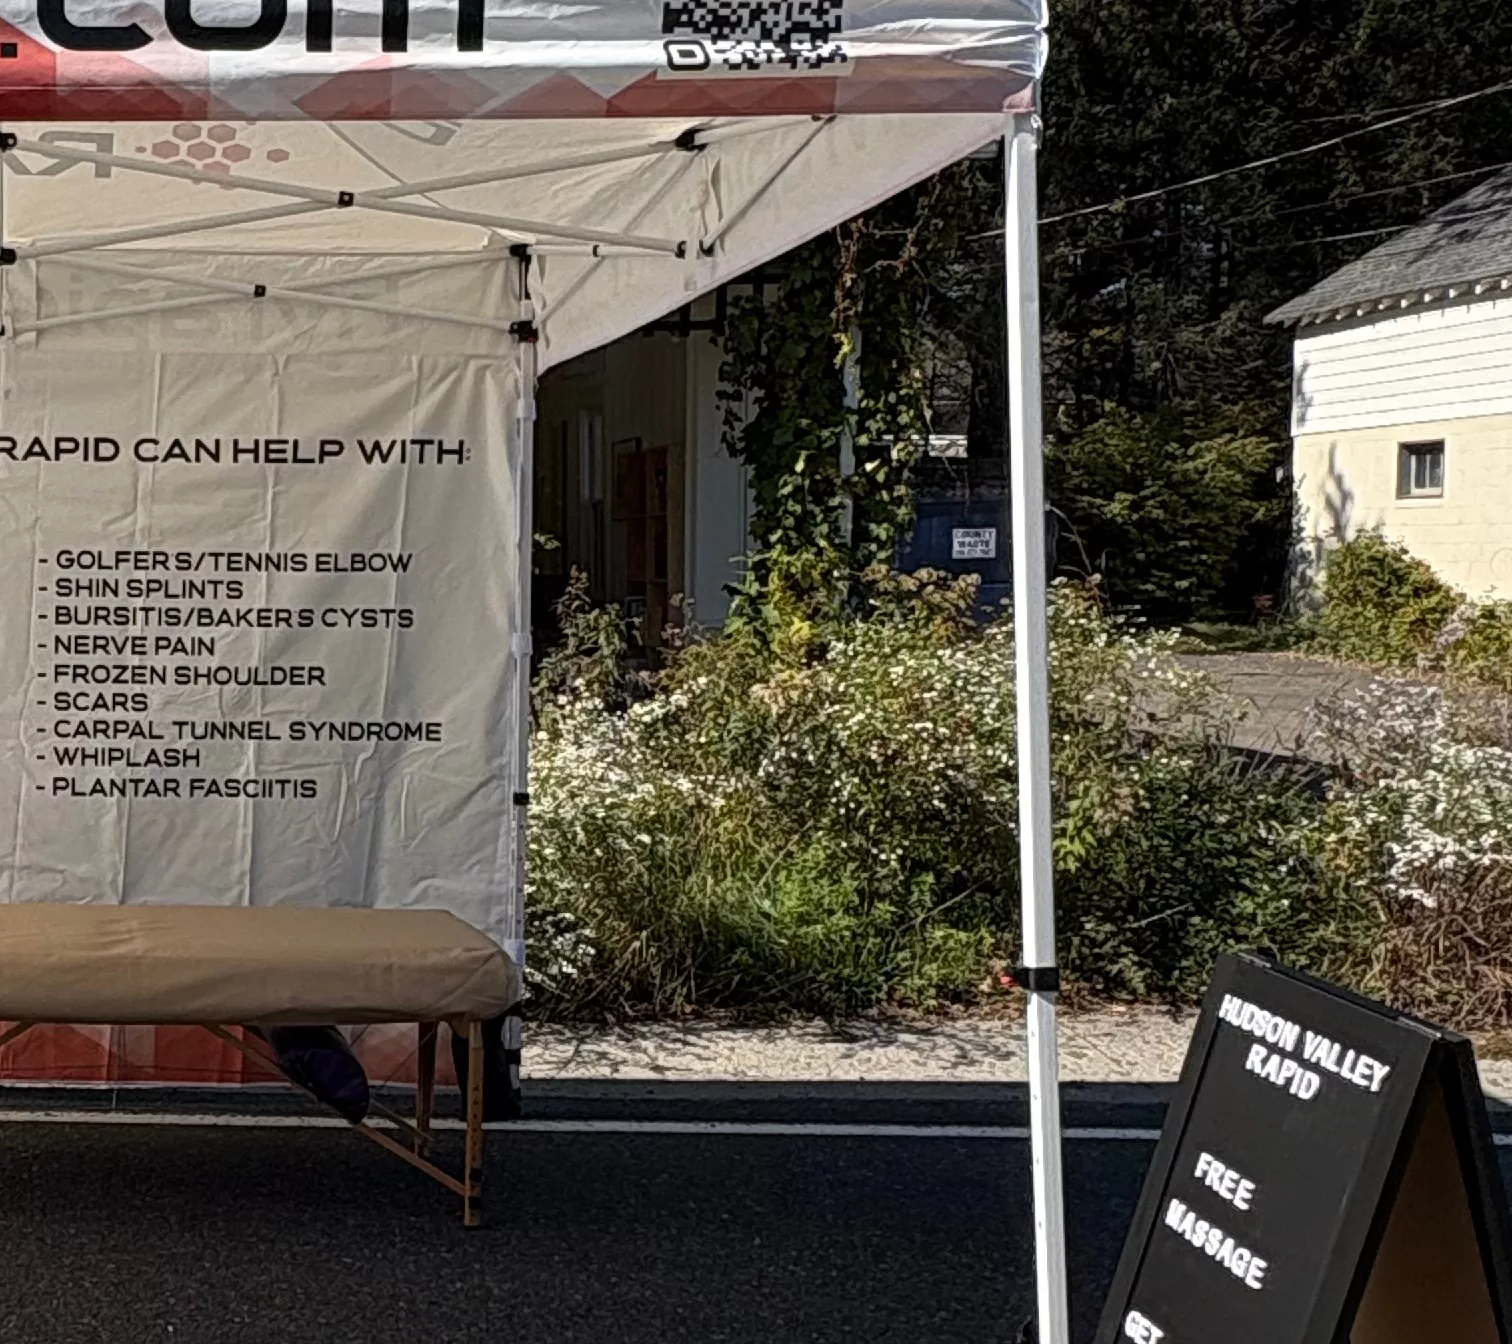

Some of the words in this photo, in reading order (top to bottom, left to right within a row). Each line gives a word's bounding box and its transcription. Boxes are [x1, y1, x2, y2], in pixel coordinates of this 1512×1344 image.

[134, 439, 220, 463] CAN
[233, 439, 344, 463] HELP
[316, 553, 412, 572] ELBOW
[56, 578, 118, 597] SHIN
[127, 579, 243, 599] SPLINTS
[321, 608, 413, 628] CYSTS
[55, 635, 147, 655] NERVE
[155, 637, 214, 656] PAIN
[55, 665, 166, 685] FROZEN
[175, 666, 325, 685] SHOULDER
[55, 692, 148, 712] SCARS
[54, 720, 164, 739] CARPAL
[172, 721, 281, 740] TUNNEL
[289, 721, 441, 741] SYNDROME
[53, 747, 199, 767] WHIPLASH
[53, 777, 180, 797] PLANTAR
[190, 779, 317, 798] FASCIITIS
[1220, 995, 1300, 1052] HUDSON
[1303, 1025, 1390, 1092] VALLEY
[1246, 1043, 1321, 1101] RAPID
[1194, 1152, 1256, 1210] FREE
[1164, 1199, 1267, 1289] MASSAGE
